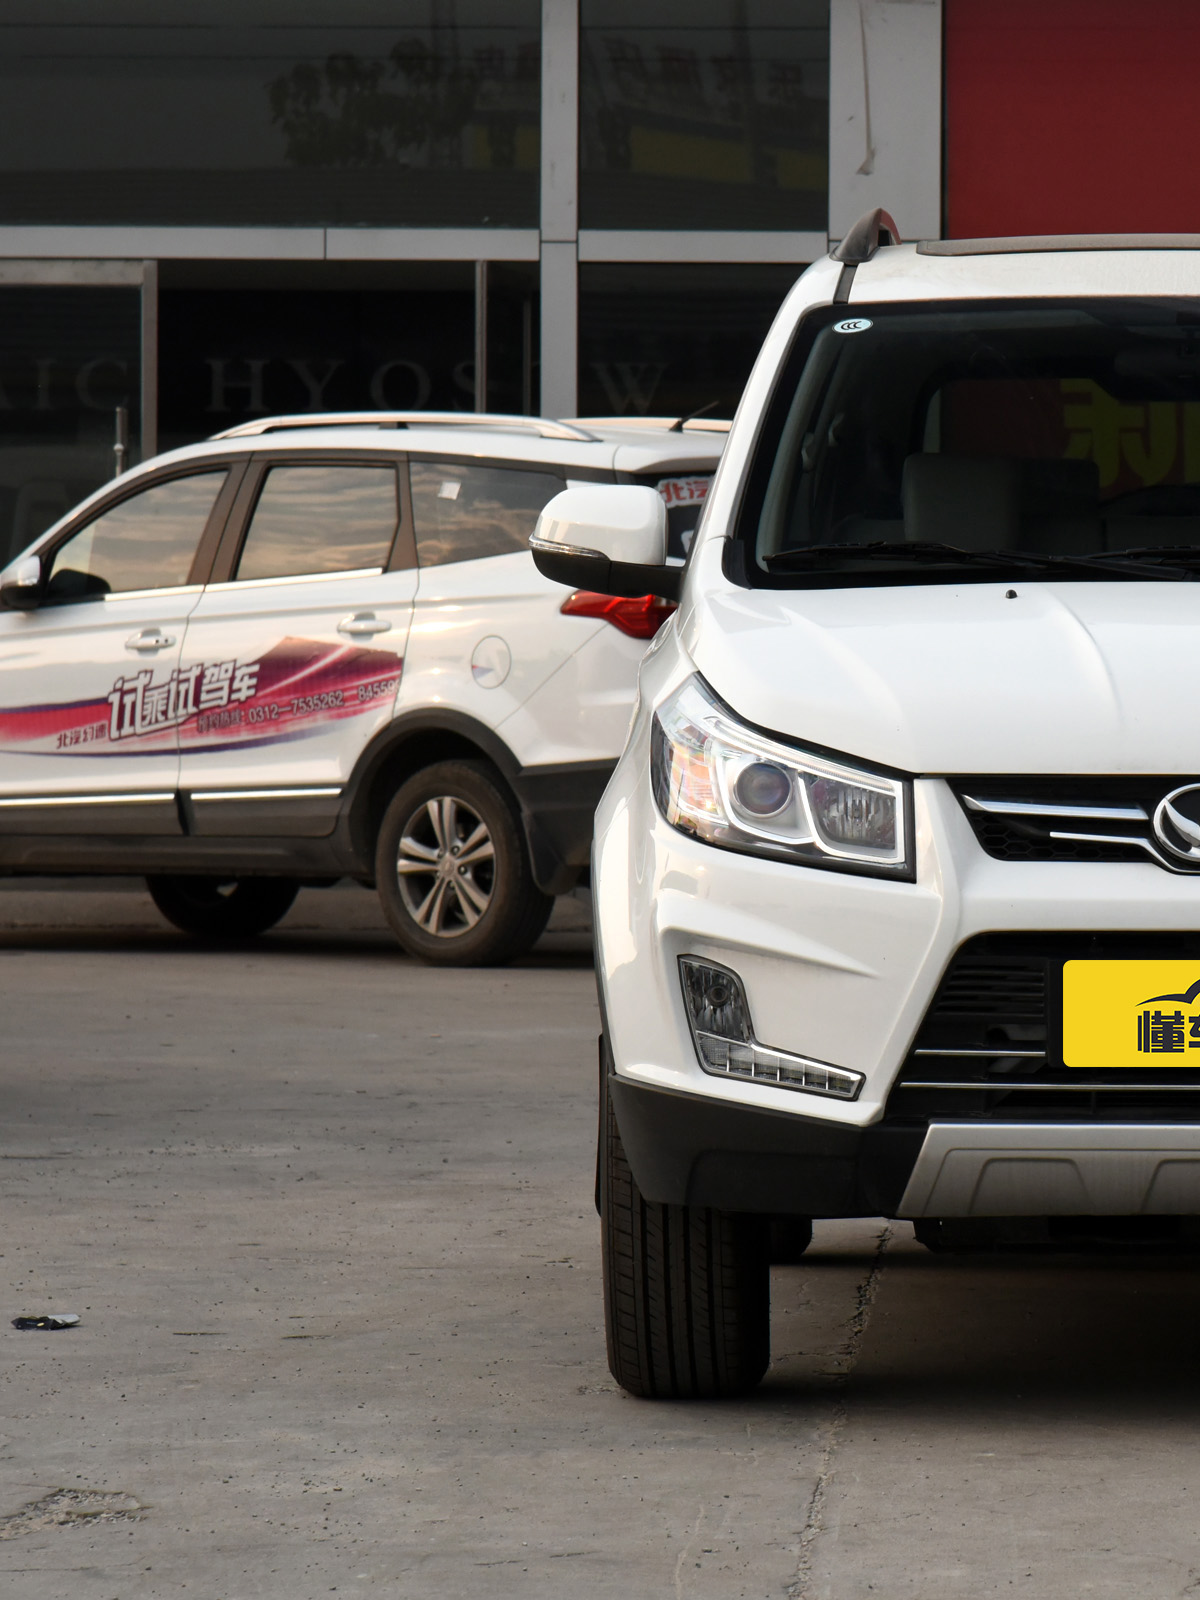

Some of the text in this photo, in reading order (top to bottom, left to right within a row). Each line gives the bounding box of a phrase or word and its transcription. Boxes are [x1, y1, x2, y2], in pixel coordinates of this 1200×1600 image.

[108, 659, 261, 741] 试乘试驾车
